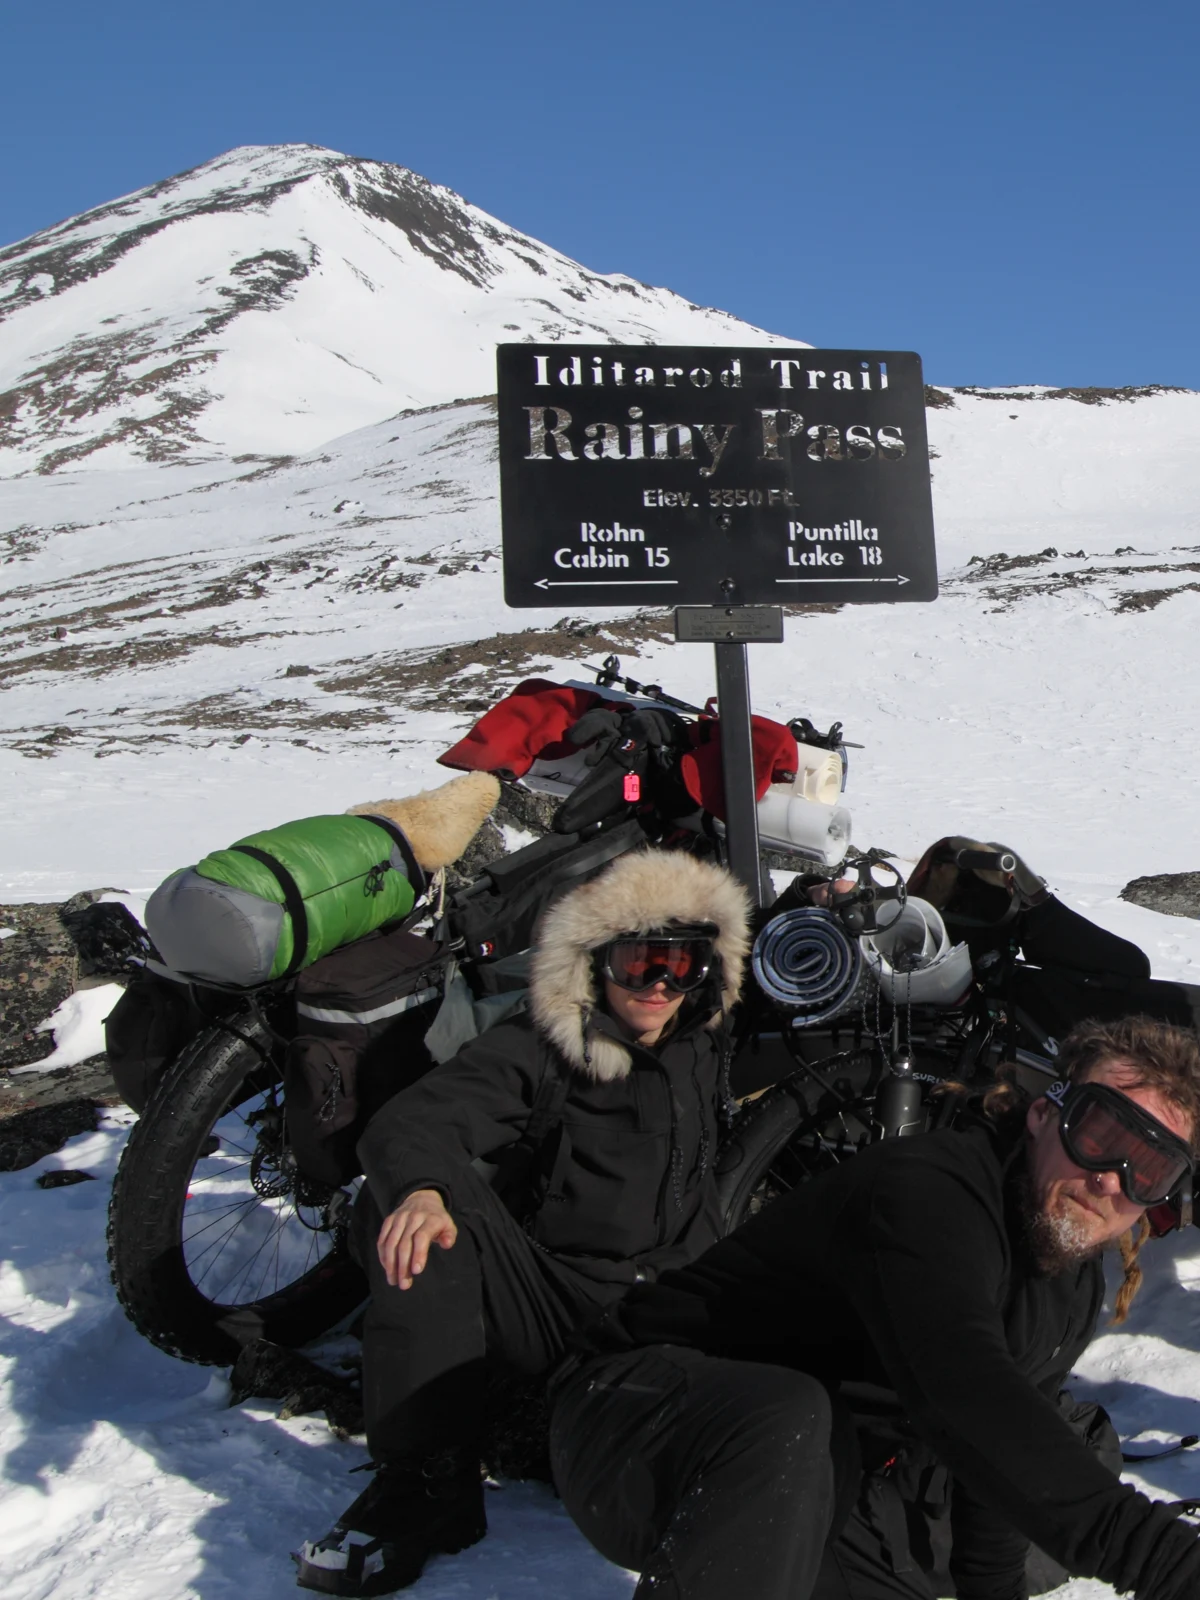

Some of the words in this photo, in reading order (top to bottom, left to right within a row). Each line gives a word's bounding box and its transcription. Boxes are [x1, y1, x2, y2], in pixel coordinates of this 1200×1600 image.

[533, 355, 743, 389] Iditarod
[770, 359, 889, 391] Trail
[522, 405, 737, 477] Rainy
[755, 407, 907, 462] Pass
[643, 489, 699, 508] Elev.
[708, 488, 762, 508] 3350
[580, 522, 645, 543] Rohn
[789, 519, 879, 542] Puntilla
[554, 546, 630, 570] Cabin
[645, 547, 671, 568] 15
[787, 545, 845, 567] Lake
[858, 546, 883, 566] 18
